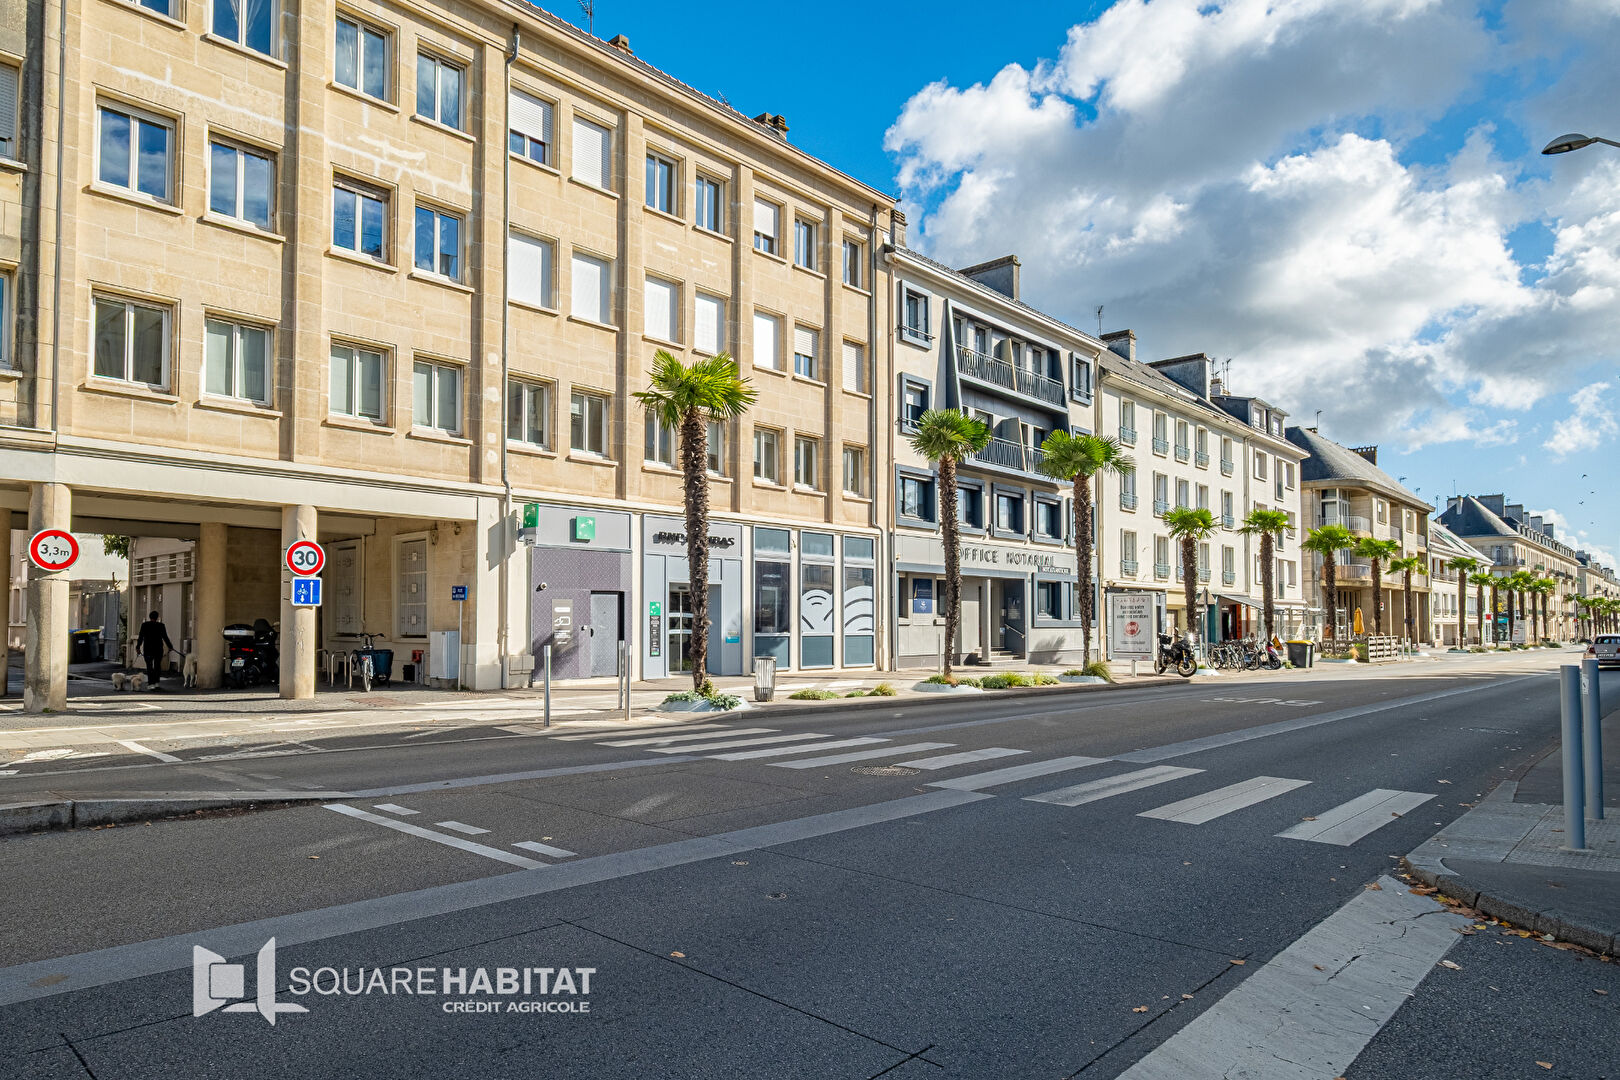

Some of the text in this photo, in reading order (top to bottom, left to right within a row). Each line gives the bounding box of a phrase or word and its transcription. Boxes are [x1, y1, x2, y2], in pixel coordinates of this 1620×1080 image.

[658, 531, 685, 543] BNP
[294, 550, 318, 566] 30
[1006, 551, 1054, 567] NOTARIAL
